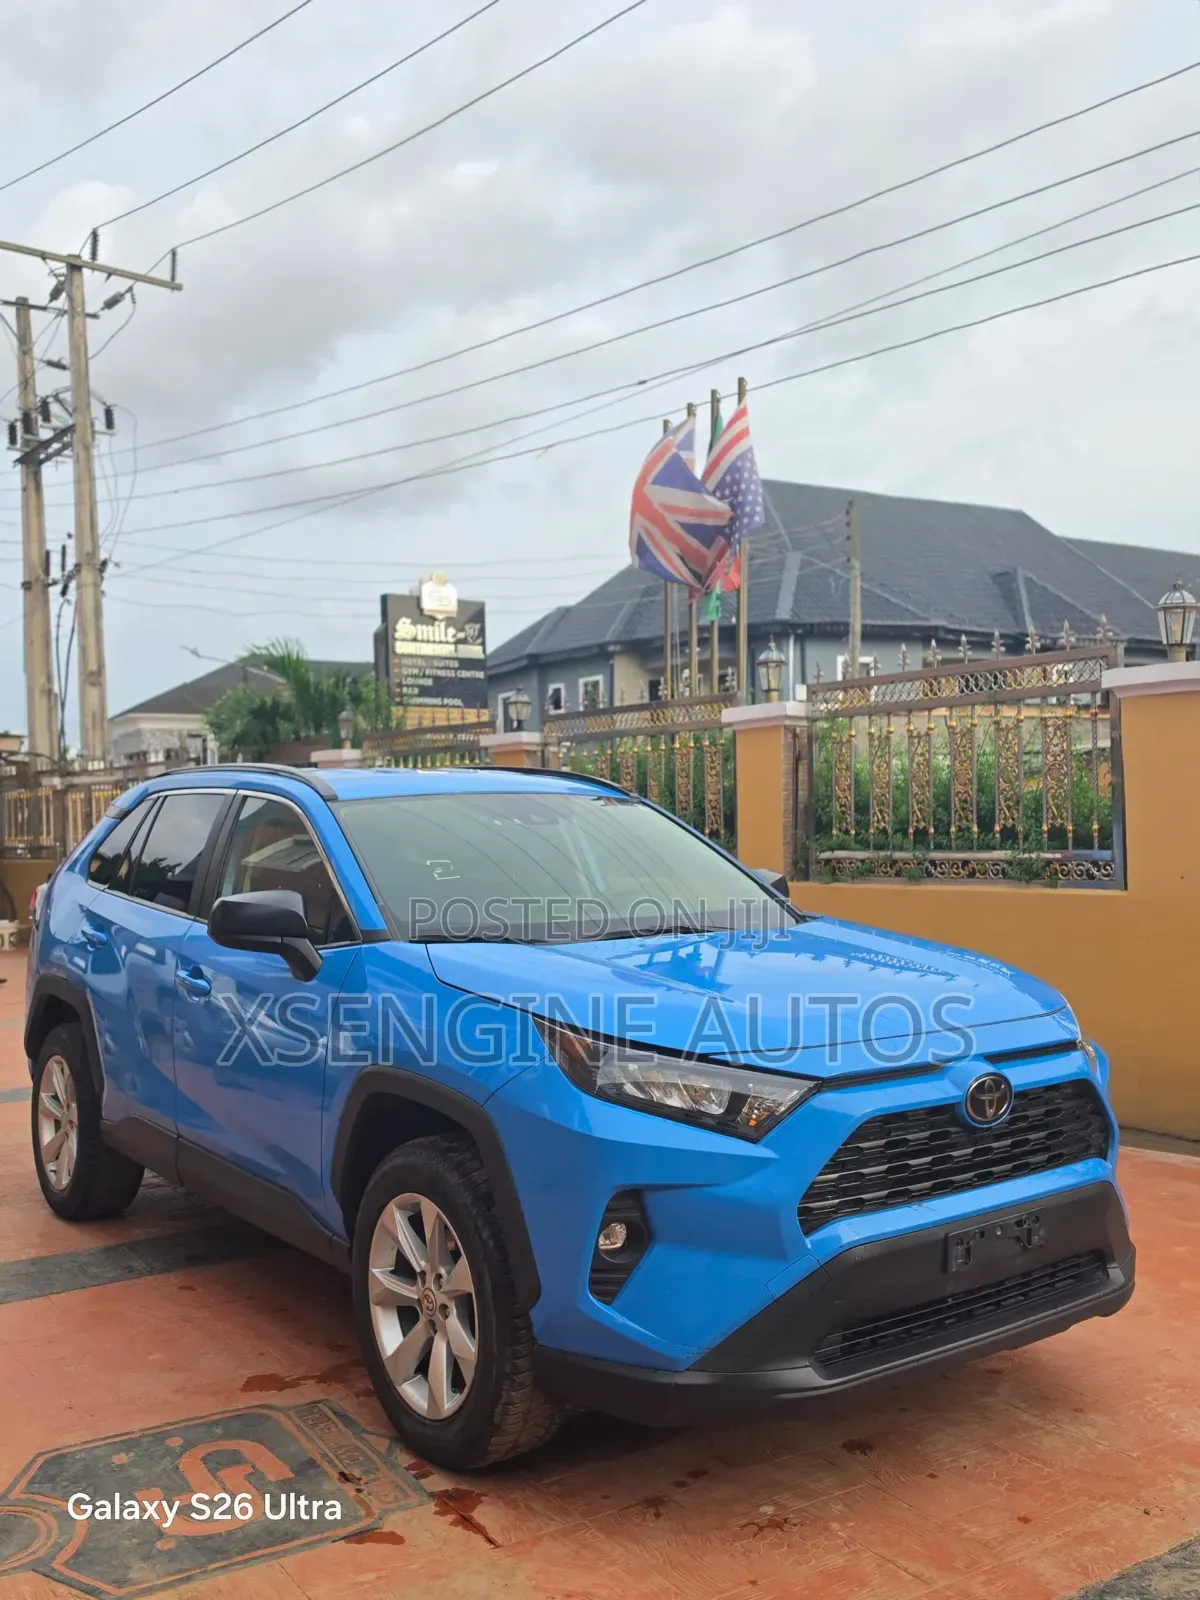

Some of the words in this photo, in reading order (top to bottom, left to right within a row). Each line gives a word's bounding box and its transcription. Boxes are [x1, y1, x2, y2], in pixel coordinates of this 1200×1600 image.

[401, 657, 426, 667] HOTEL
[434, 660, 460, 669] SUITES
[402, 668, 420, 677] GYM
[425, 669, 456, 679] FITNESS
[456, 670, 485, 680] CENTRE
[402, 677, 434, 687] LOUNGE
[443, 698, 463, 707] POOL
